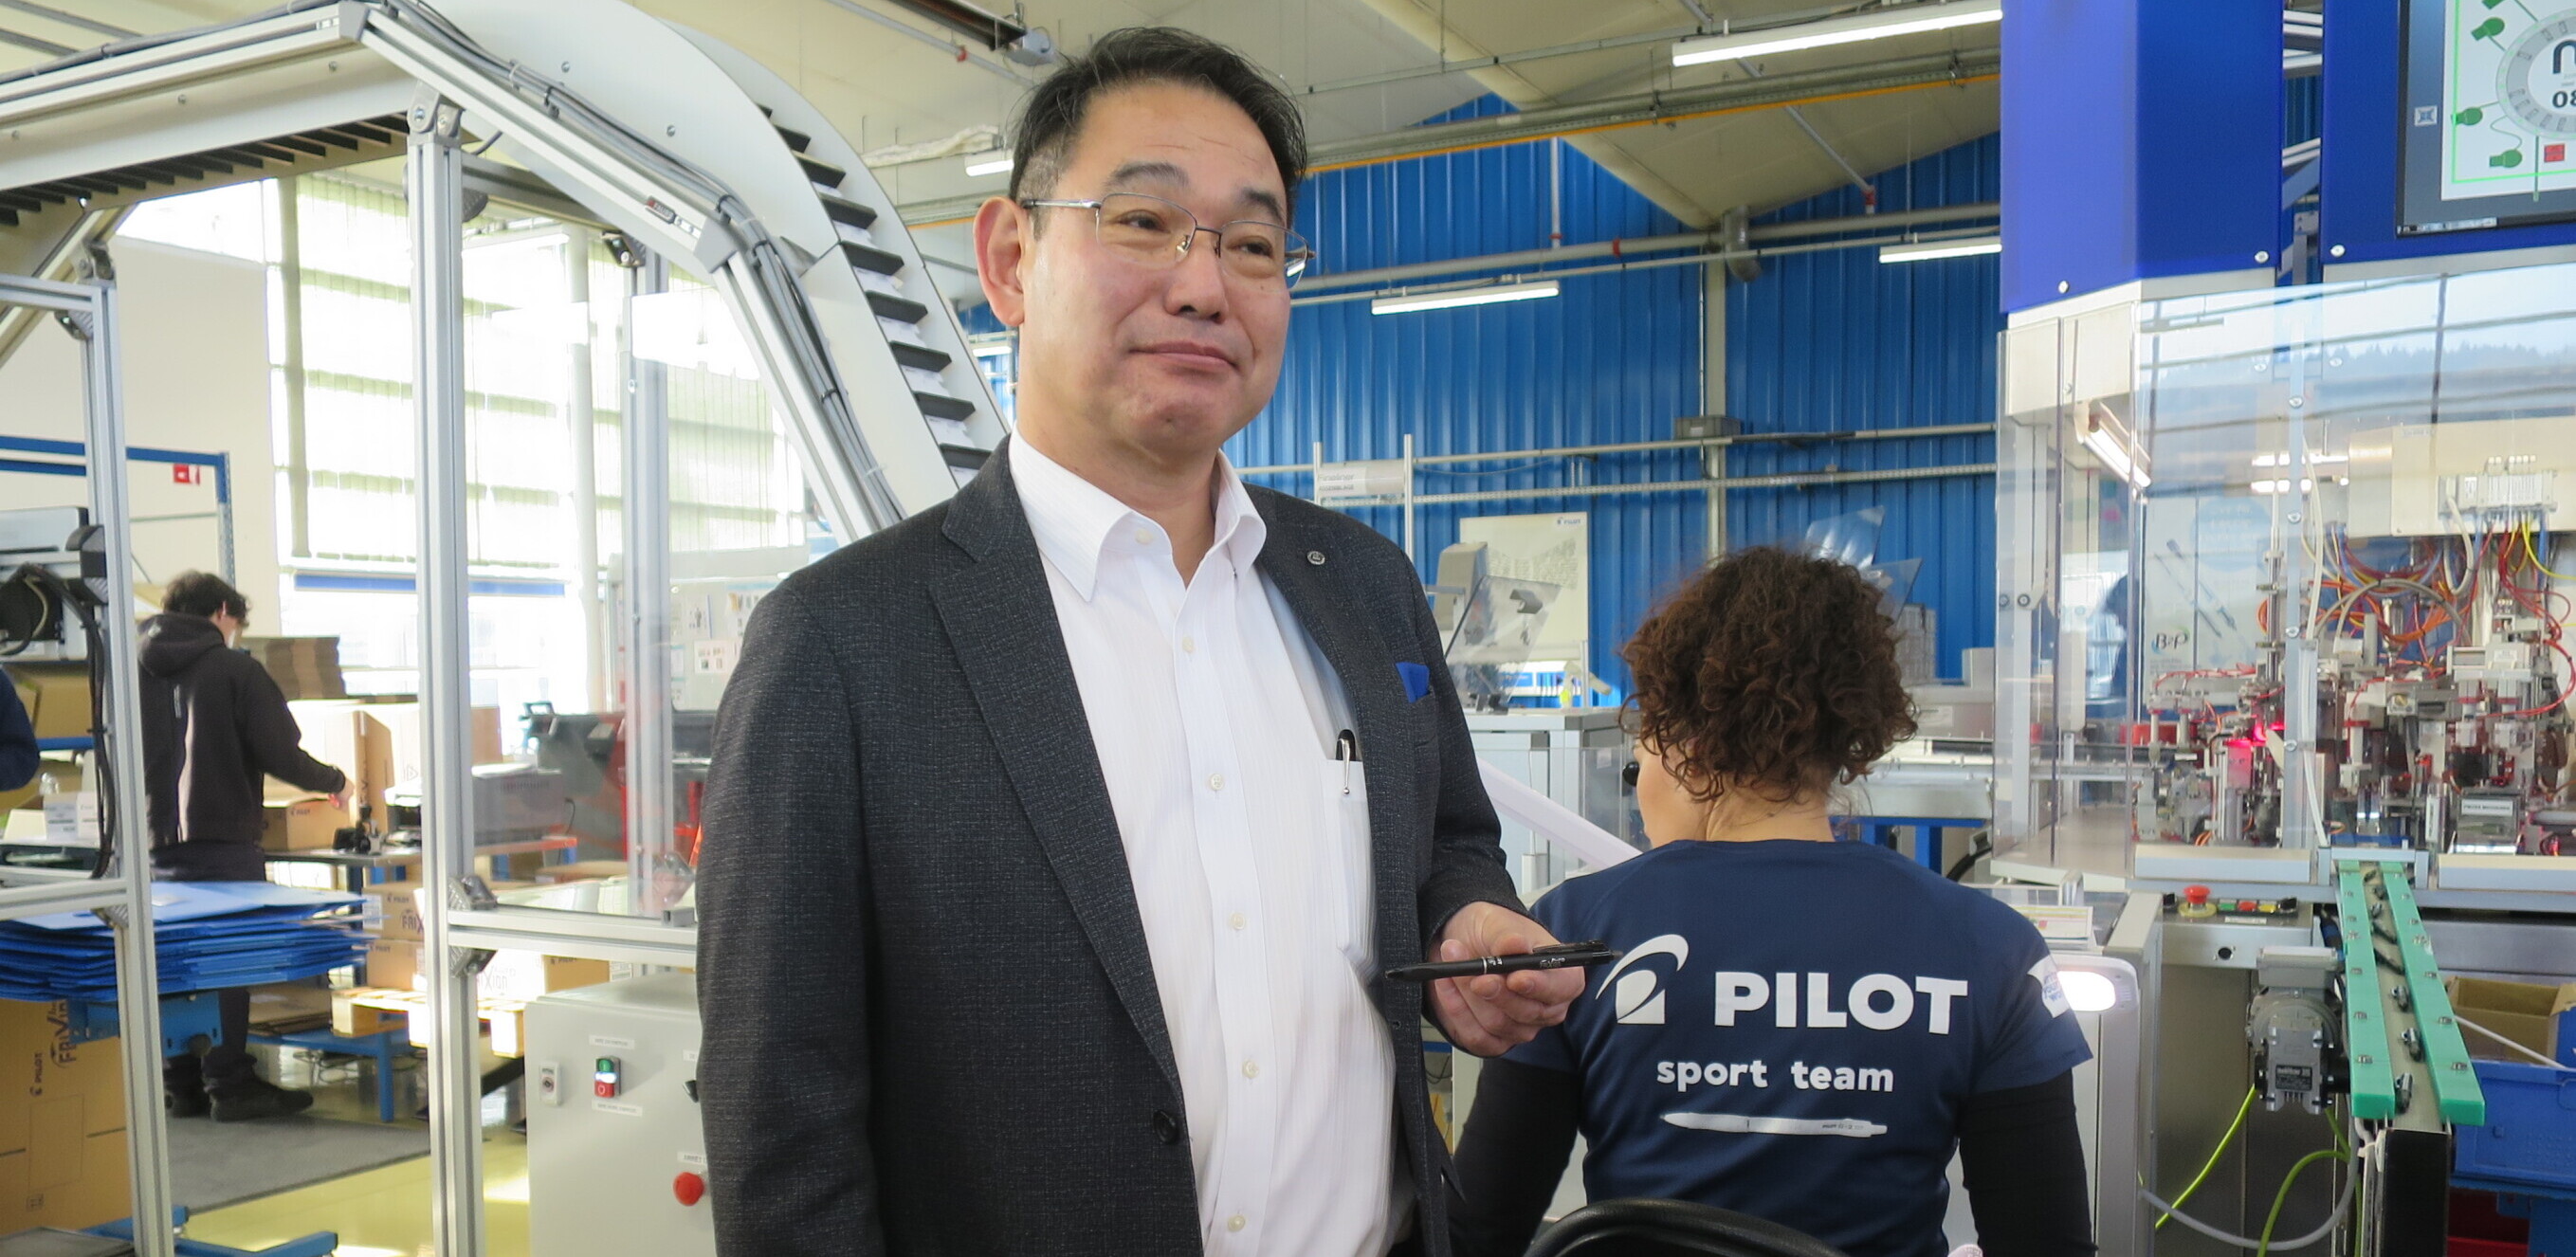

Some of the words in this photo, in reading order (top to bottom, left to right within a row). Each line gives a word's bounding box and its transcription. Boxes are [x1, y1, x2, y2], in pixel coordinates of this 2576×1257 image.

[1714, 972, 1968, 1035] PILOT
[34, 1051, 43, 1083] PILOT
[1657, 1060, 1768, 1092] sport
[1791, 1061, 1894, 1092] team
